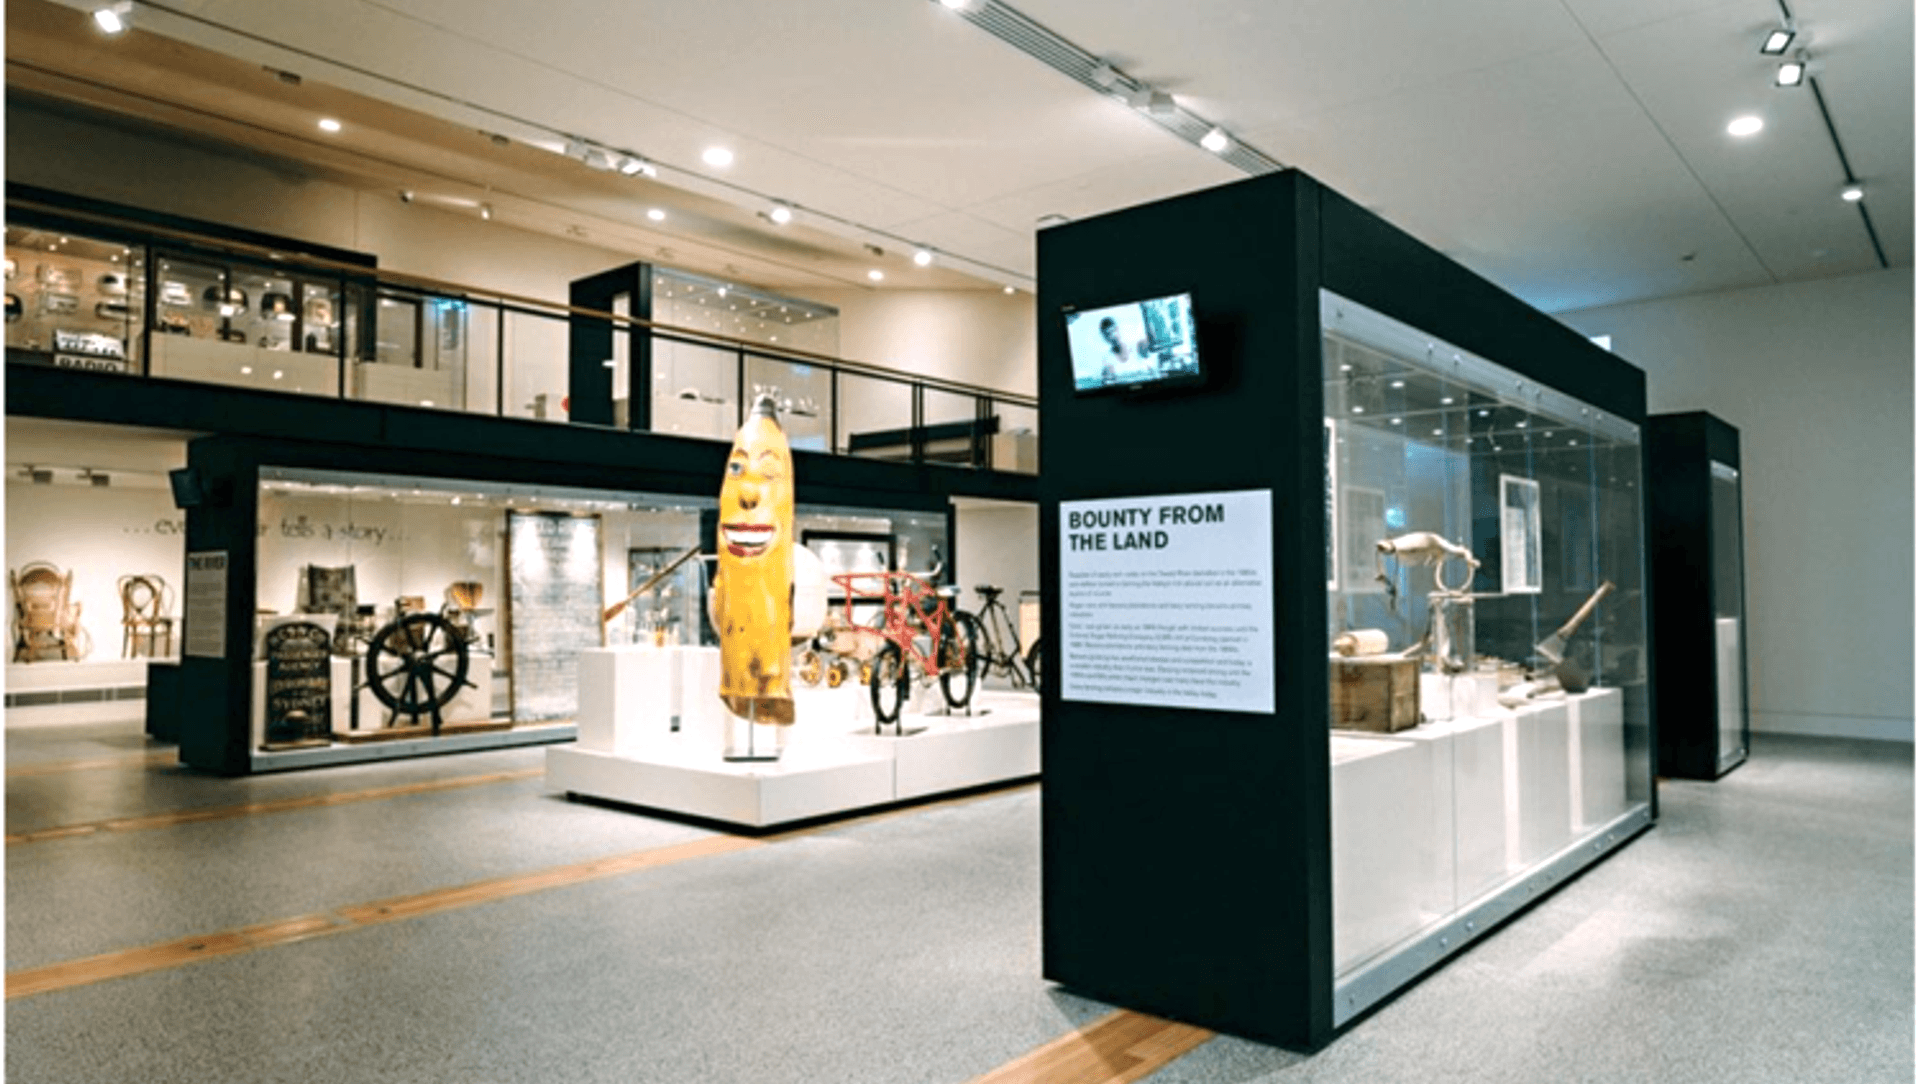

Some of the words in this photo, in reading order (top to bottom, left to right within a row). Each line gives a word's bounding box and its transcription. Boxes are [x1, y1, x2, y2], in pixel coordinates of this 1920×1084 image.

[60, 356, 117, 371] RADIO
[1069, 508, 1152, 529] BOUNTY
[1159, 504, 1225, 525] FROM
[1069, 533, 1107, 551] THE
[1113, 531, 1169, 550] LAND
